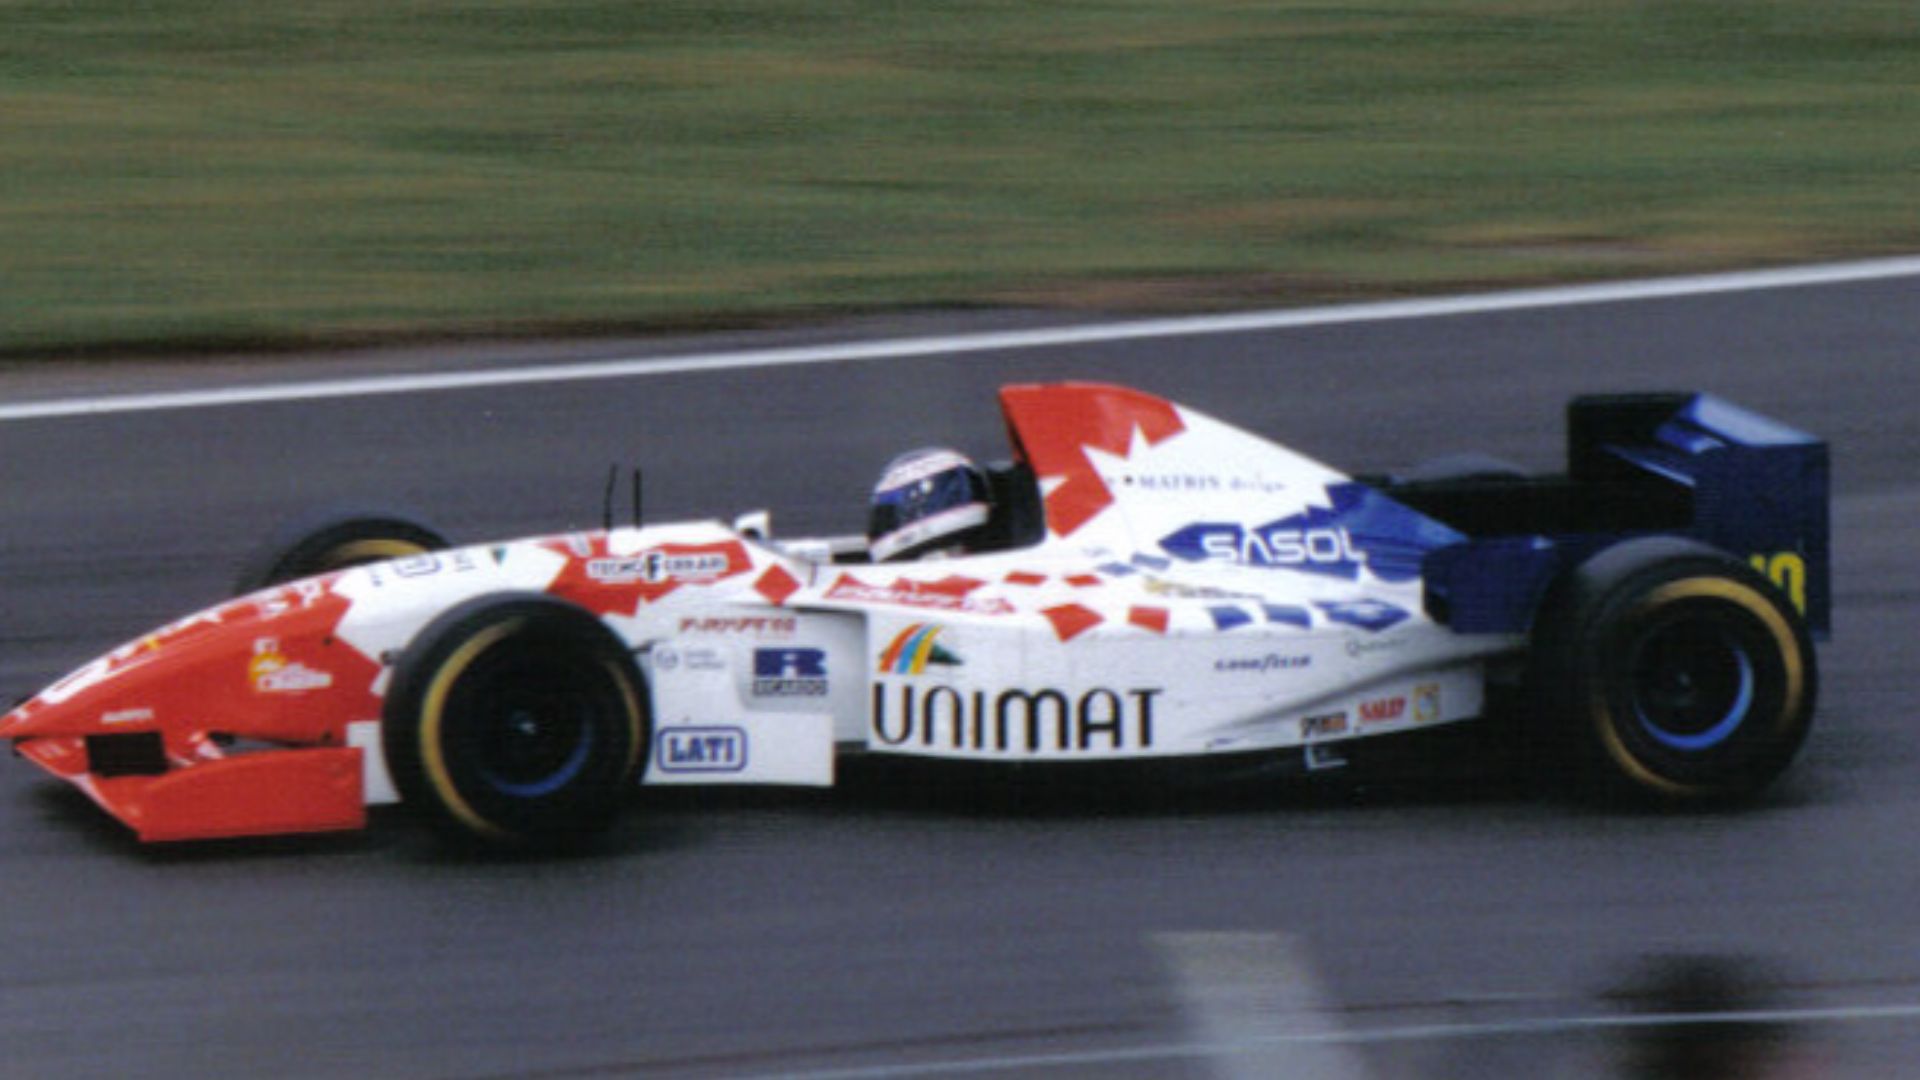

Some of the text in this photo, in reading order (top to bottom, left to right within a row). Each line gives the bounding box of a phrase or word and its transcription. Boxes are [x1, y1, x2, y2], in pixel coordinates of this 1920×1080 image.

[1201, 527, 1366, 564] SASOL
[872, 682, 1163, 750] UNIMAT
[668, 736, 735, 763] LATI
